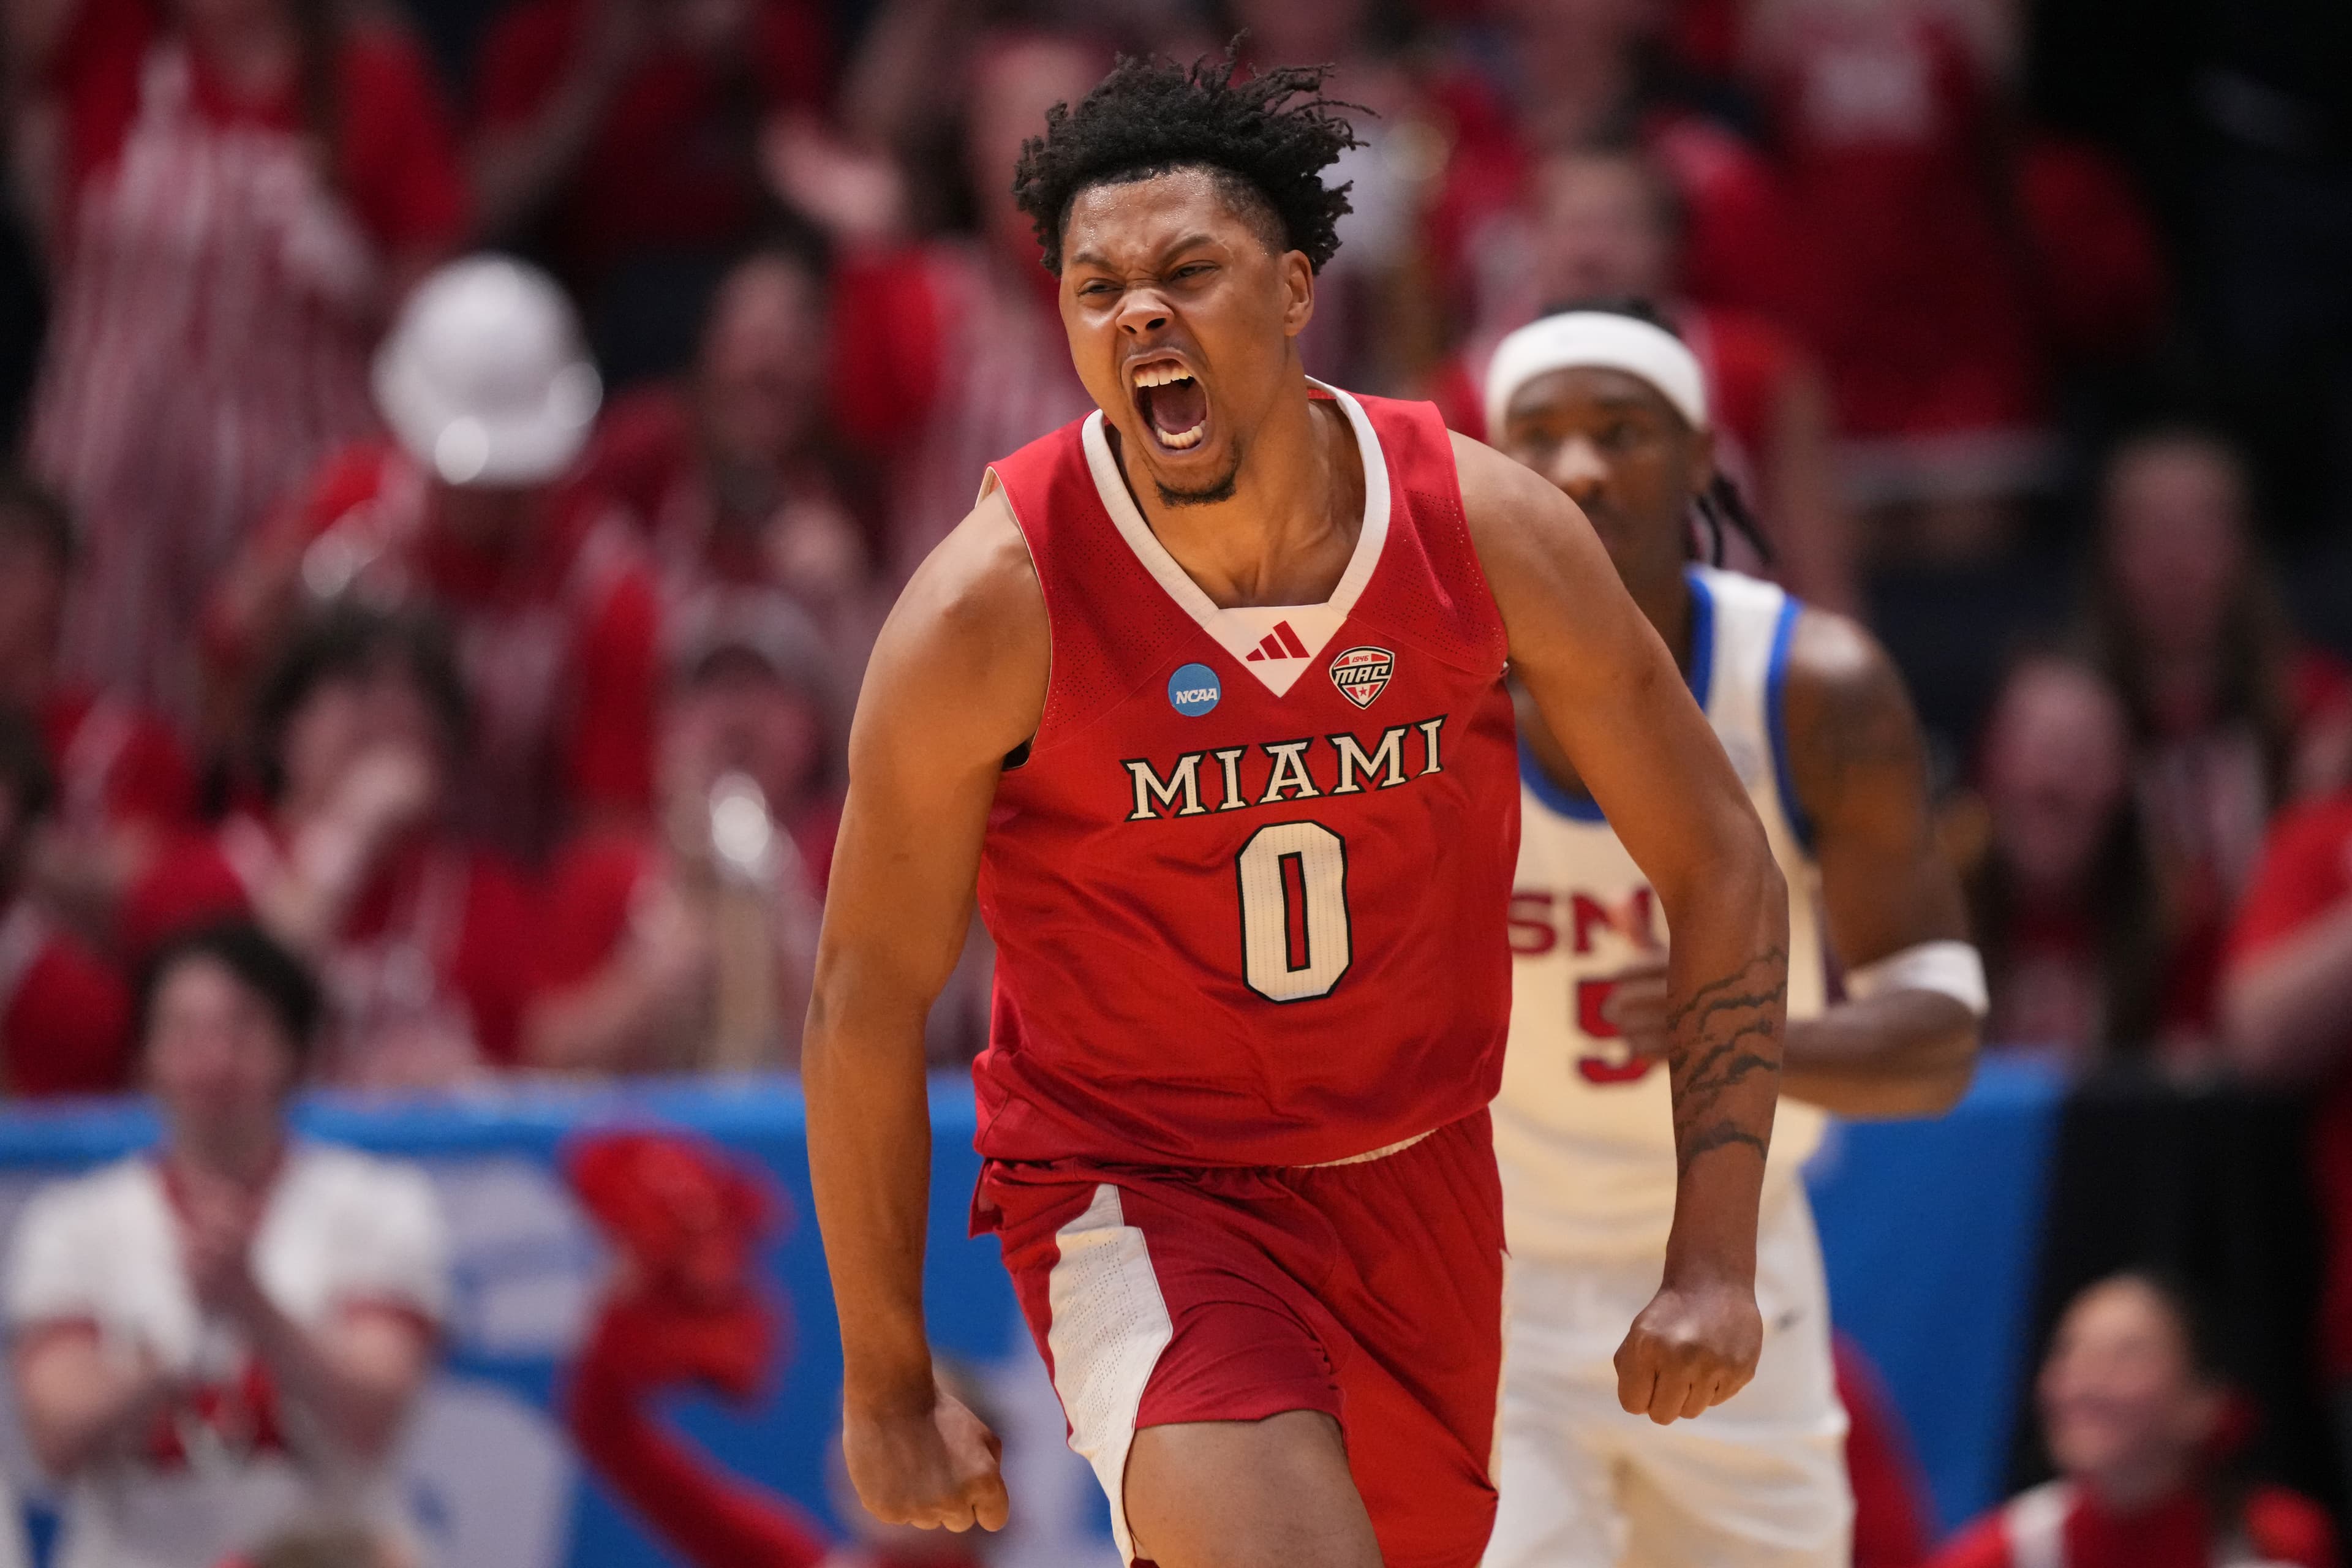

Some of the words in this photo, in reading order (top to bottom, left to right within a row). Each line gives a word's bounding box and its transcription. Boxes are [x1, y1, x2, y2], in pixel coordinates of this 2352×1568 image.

[1176, 688, 1218, 704] NCAA
[1335, 665, 1390, 685] MAC
[1120, 714, 1448, 822] MIAMI
[1234, 820, 1352, 1005] 0
[1509, 888, 1654, 955] SM
